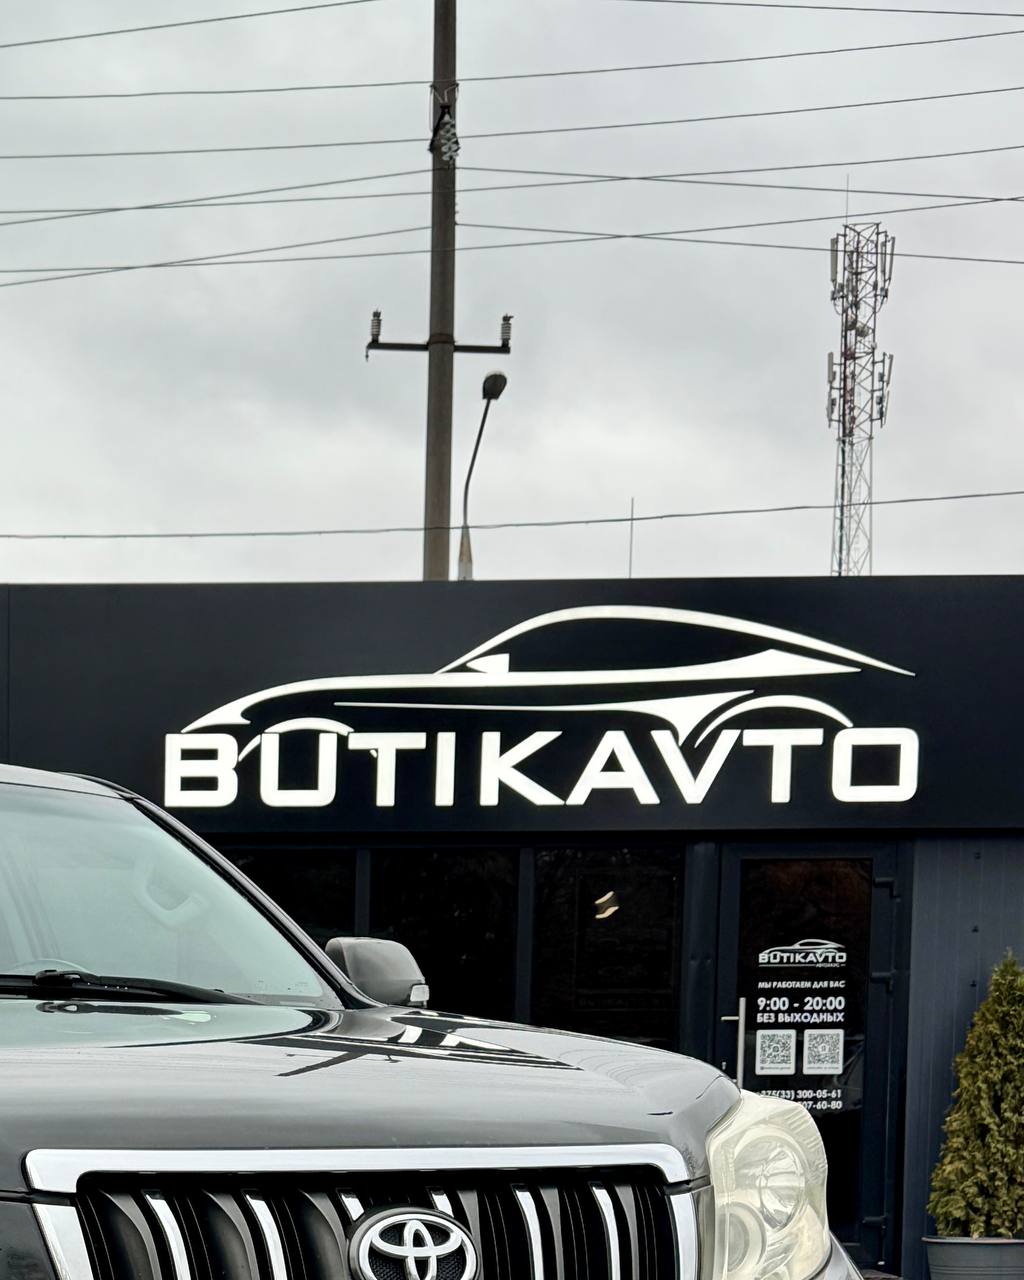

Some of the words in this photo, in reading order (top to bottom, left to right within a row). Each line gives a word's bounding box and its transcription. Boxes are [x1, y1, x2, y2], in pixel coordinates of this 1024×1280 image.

[164, 727, 920, 808] BUTIKAVTO
[758, 952, 847, 964] BUTIKAVTO
[772, 980, 812, 989] РАБОТАЕМ
[757, 997, 789, 1011] 9:00
[803, 996, 845, 1010] 20:00
[757, 1012, 775, 1023] БЕЗ
[777, 1012, 845, 1024] ВЫХОДНЫХ
[796, 1089, 842, 1099] 300-05-61
[802, 1100, 843, 1110] 07-60-80
